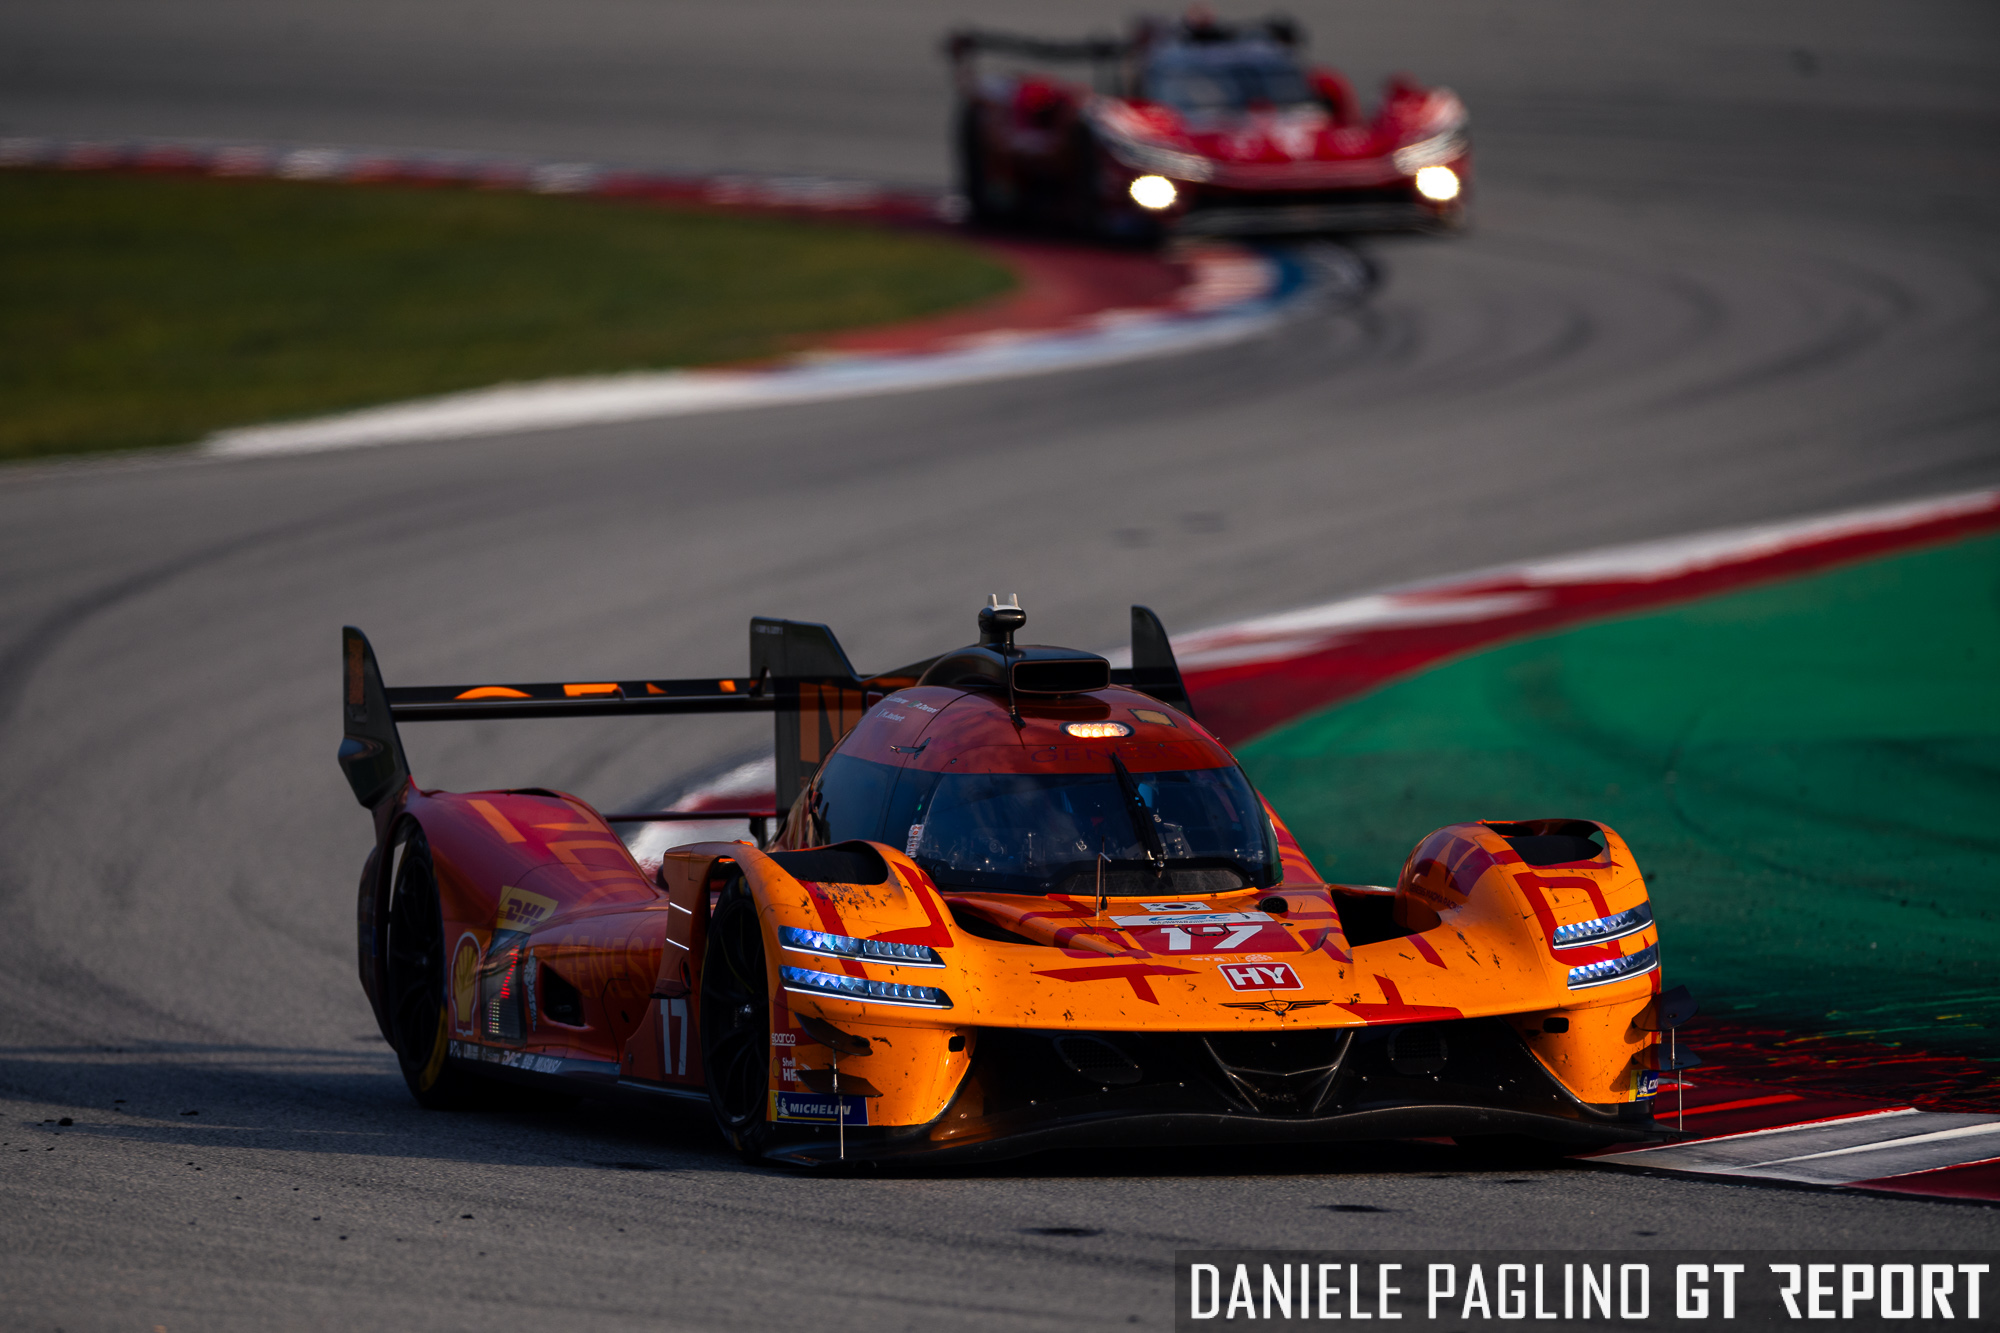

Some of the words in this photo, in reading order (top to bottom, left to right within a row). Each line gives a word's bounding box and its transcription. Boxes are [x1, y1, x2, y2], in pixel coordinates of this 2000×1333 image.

[1031, 745, 1189, 763] GENESIS
[505, 898, 546, 927] DHL
[1160, 924, 1263, 951] 17
[555, 934, 664, 999] GENESI
[1227, 966, 1286, 986] HY
[660, 999, 688, 1076] 17
[771, 1033, 796, 1045] sparco
[782, 1057, 796, 1067] Shell
[789, 1103, 851, 1115] MICHELIN
